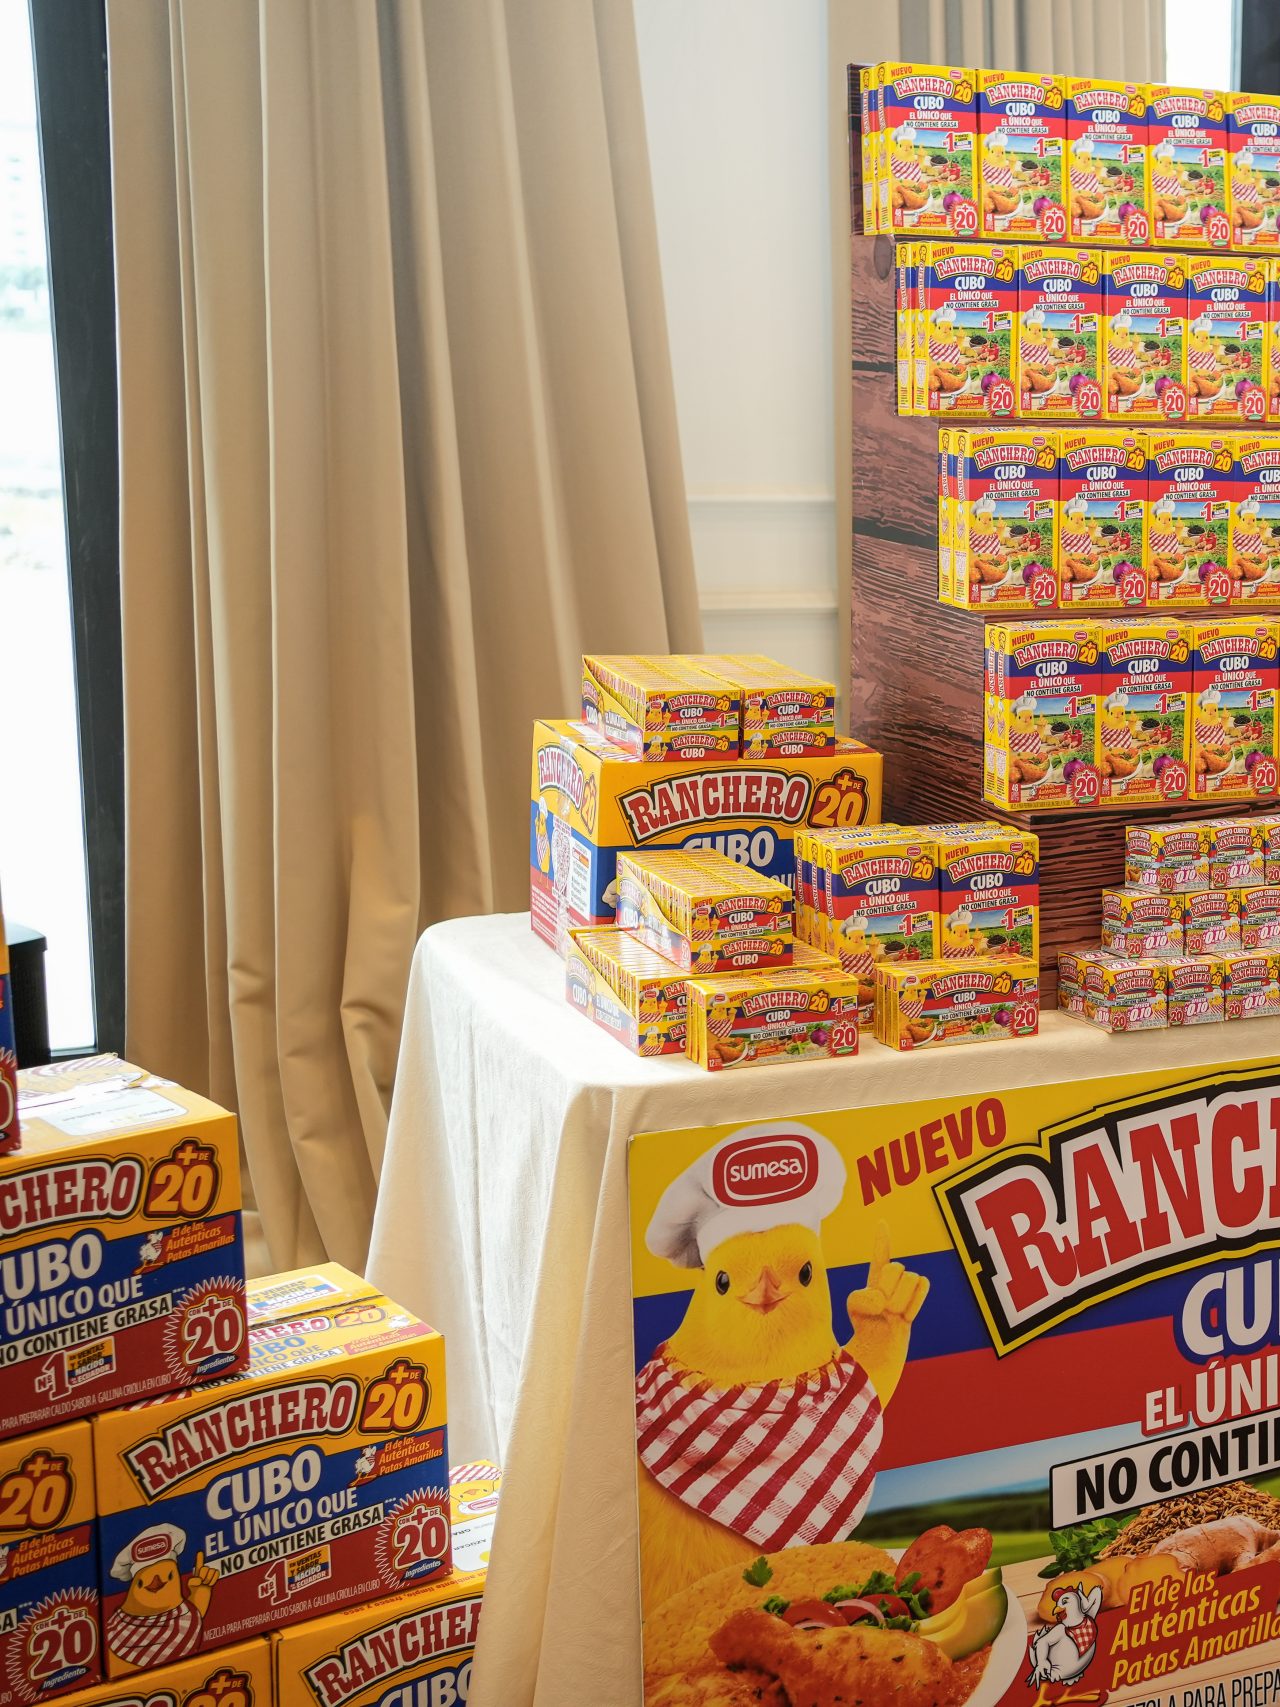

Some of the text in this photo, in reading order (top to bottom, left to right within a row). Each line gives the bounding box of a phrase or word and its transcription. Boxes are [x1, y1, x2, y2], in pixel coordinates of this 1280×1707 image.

[894, 77, 972, 102] RANCHERO 20
[913, 96, 944, 110] CUBO
[909, 110, 952, 121] EL ÚNICO QUE
[915, 121, 939, 129] CONTIENE
[940, 121, 957, 129] GRASA
[936, 258, 995, 278] RANCHERO
[955, 277, 986, 290] CUBO
[977, 446, 1036, 467] RANCHERO
[994, 465, 1026, 479] CUBO
[1011, 634, 1036, 647] NUEVO
[1014, 641, 1097, 667] RANCHERO 20
[1030, 675, 1076, 689] EL ÚNICO QUE
[1035, 660, 1068, 678] CUBO
[1026, 684, 1081, 698] NO CONTIENE GRASA
[679, 706, 703, 719] CUBO
[671, 732, 716, 750] RANCHERO
[1076, 778, 1099, 798] 20
[624, 770, 864, 841] RANCHERO 20
[842, 857, 912, 885] RANCHERO
[865, 878, 901, 896] CUBO
[1132, 906, 1169, 921] RANCHERO
[1133, 897, 1168, 908] NUEVO CUBITO
[743, 990, 809, 1017] RANCHERO
[765, 1010, 791, 1022] CUBO
[857, 1098, 1007, 1206] NUEVO
[730, 1154, 804, 1183] sumesa
[0, 1160, 213, 1232] CHERO 20
[6, 1274, 144, 1337] ÚNICO QUE
[23, 1299, 170, 1358] CONTIENE GRASA
[1145, 1387, 1184, 1431] EL
[129, 1379, 424, 1497] RANCHERO 20
[379, 1438, 430, 1464] Auténticas
[380, 1446, 443, 1476] Patas Amarillas
[205, 1449, 322, 1521] CUBO
[1076, 1457, 1138, 1516] NO
[1, 1474, 68, 1528] 20
[205, 1486, 358, 1557] EL ÚNICO QUE
[12, 1535, 75, 1566] Auténticas
[137, 1540, 166, 1555] sumesa
[220, 1506, 382, 1576] NO CONTIENE GRASA
[394, 1514, 448, 1570] 20
[13, 1543, 91, 1578] Patas Amarillas
[404, 1558, 442, 1579] Ingredientes
[1129, 1568, 1216, 1615] El de las
[203, 1623, 227, 1642] MEZCLA
[227, 1618, 243, 1637] PARA
[242, 1611, 271, 1633] PREPARAR
[270, 1606, 289, 1626] CALDO
[289, 1601, 307, 1619] SABOR
[313, 1591, 336, 1609] GALLINA
[335, 1587, 358, 1604] CRIOLLA
[357, 1584, 365, 1597] EN
[365, 1578, 381, 1595] CUBO
[1109, 1583, 1262, 1656] Auténticas
[1111, 1650, 1180, 1690] Patas
[1185, 1677, 1230, 1707] PARA
